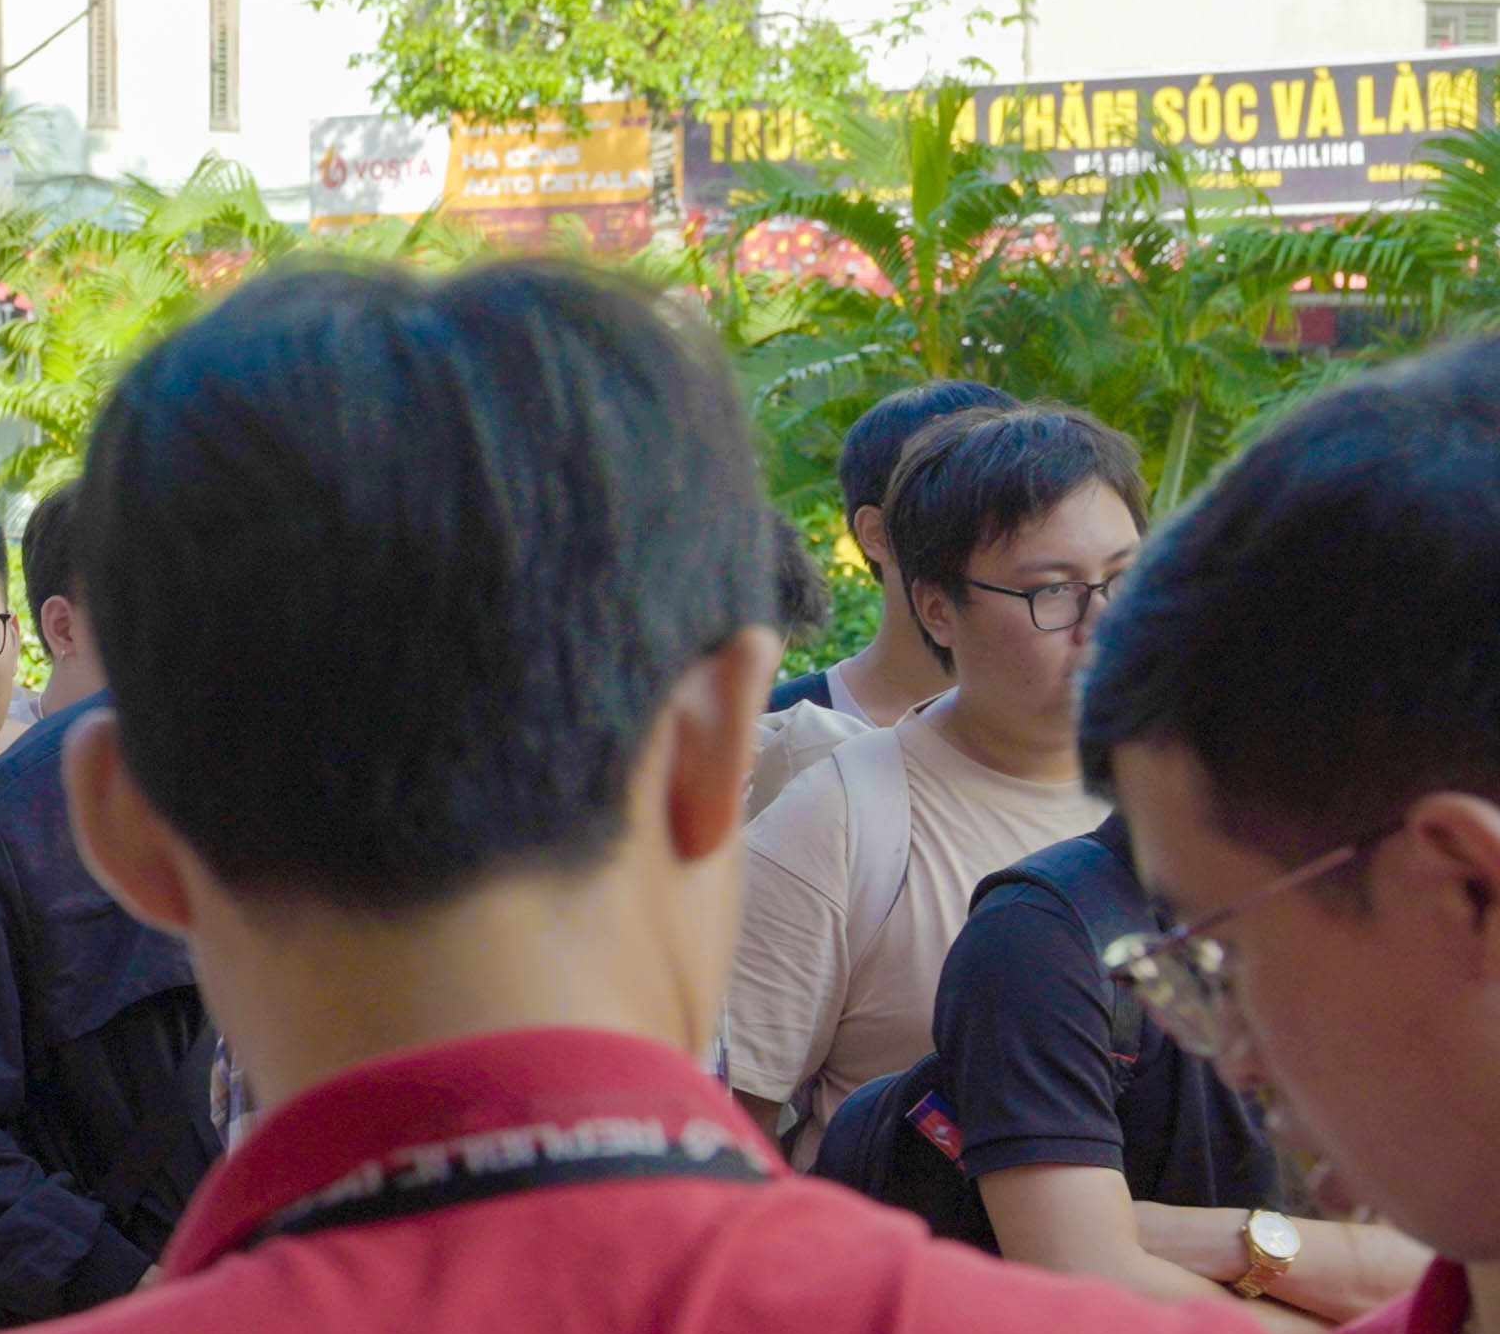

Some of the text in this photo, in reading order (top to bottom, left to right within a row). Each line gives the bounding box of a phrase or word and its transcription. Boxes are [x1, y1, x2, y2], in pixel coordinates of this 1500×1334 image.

[1152, 74, 1260, 146] SÓC
[1270, 66, 1344, 140] VÀ
[1357, 60, 1478, 137] LÀM
